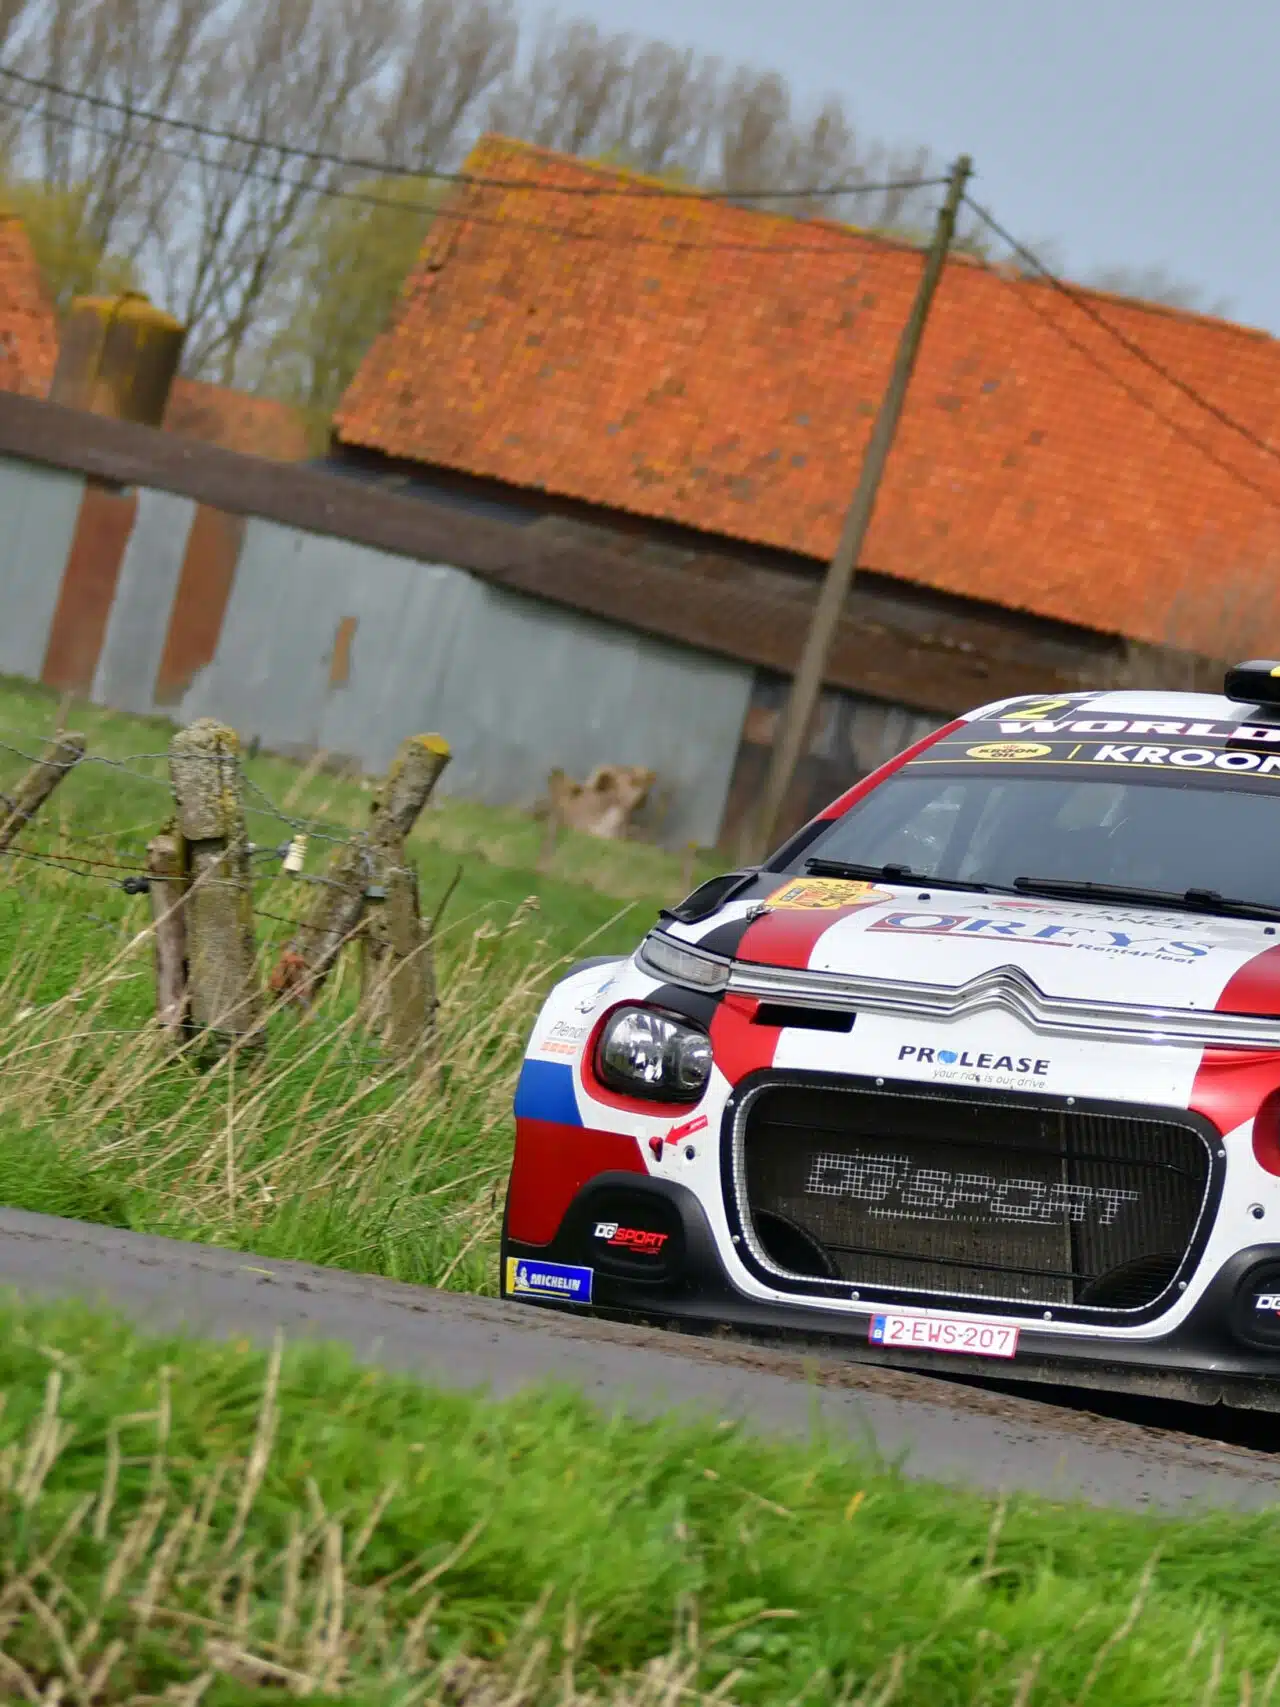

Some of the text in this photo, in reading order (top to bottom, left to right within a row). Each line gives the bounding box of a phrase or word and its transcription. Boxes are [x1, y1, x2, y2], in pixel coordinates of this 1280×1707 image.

[999, 700, 1071, 720] 2
[884, 912, 1216, 957] ORFYS
[933, 1067, 958, 1080] your
[984, 1073, 993, 1083] is
[996, 1075, 1014, 1085] our
[1017, 1077, 1045, 1089] drive
[530, 1273, 582, 1292] MICHELIN
[890, 1319, 1011, 1350] 2-EWS-207
